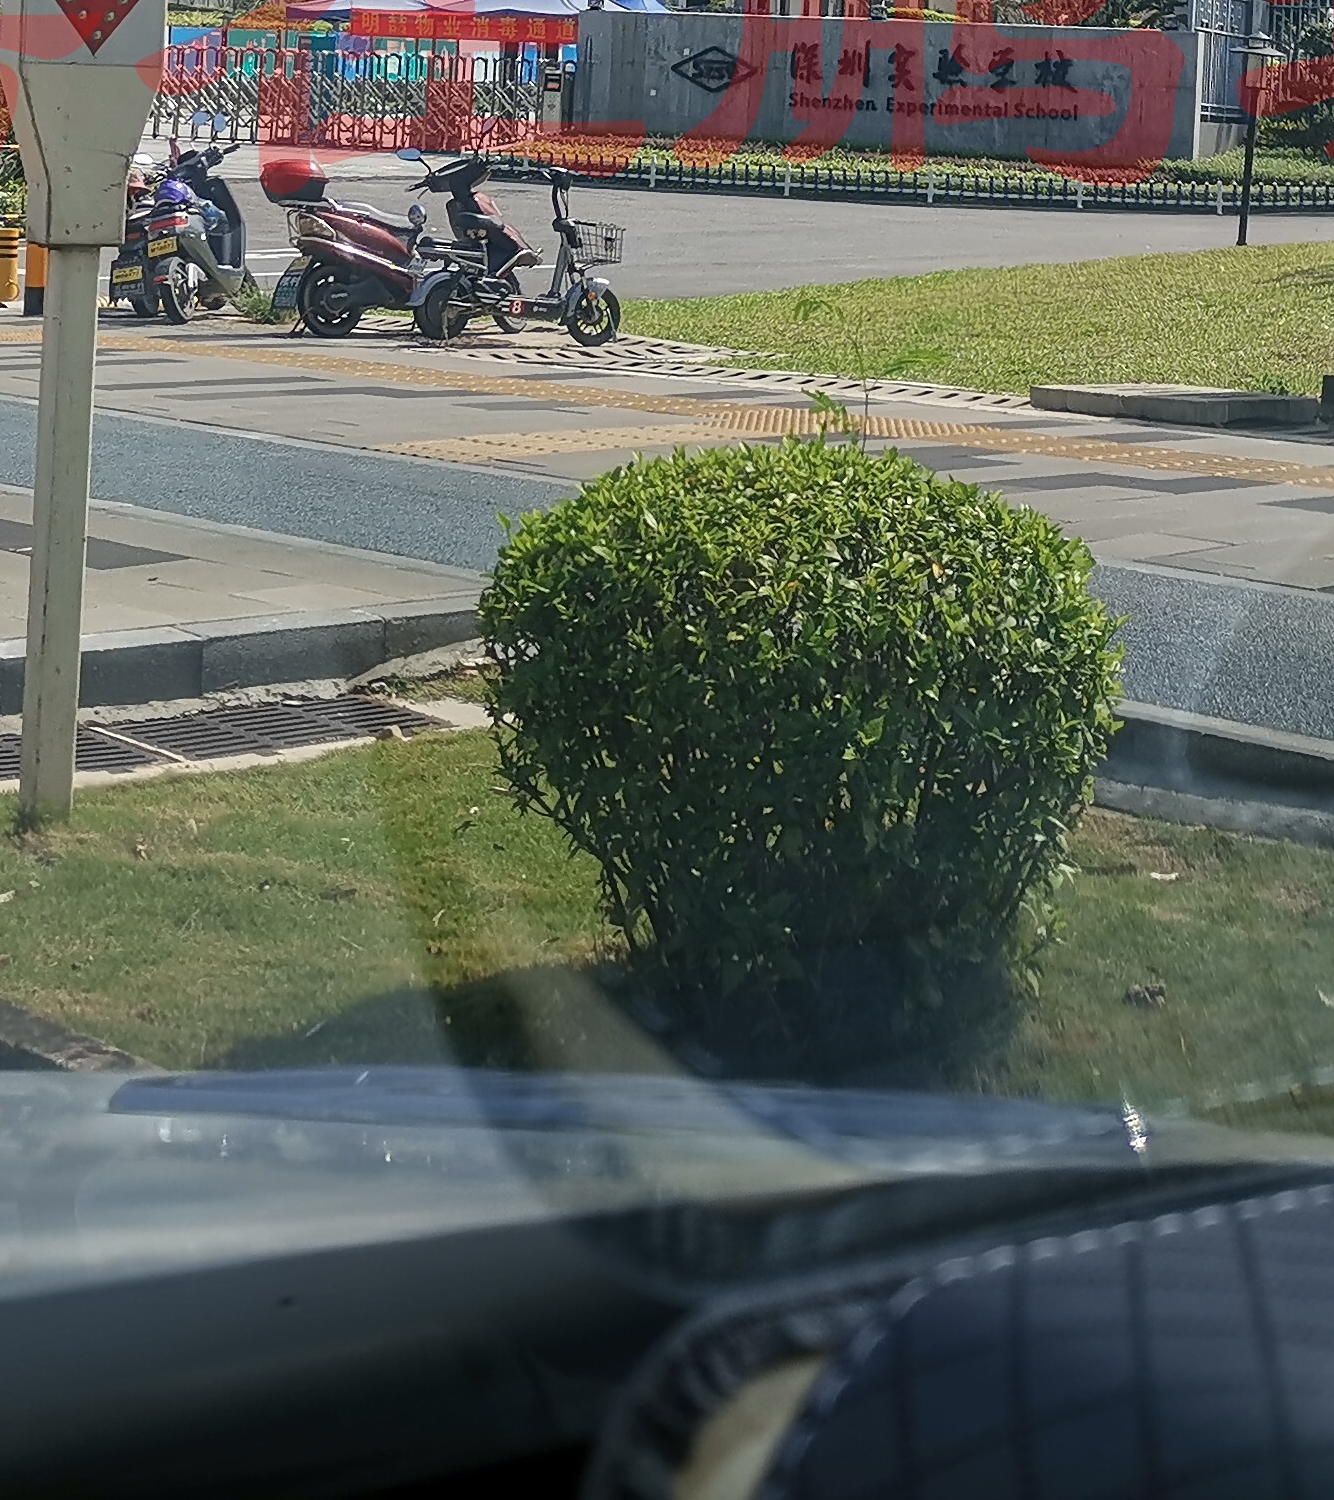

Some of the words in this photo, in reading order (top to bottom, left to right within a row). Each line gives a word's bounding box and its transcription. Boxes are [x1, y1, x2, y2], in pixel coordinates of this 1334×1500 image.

[361, 11, 575, 42] 明喆物业消毒通道
[790, 39, 1078, 95] 深圳实验学校
[789, 92, 878, 112] Shenzhen
[886, 96, 1009, 118] Experimental
[1013, 102, 1079, 121] School
